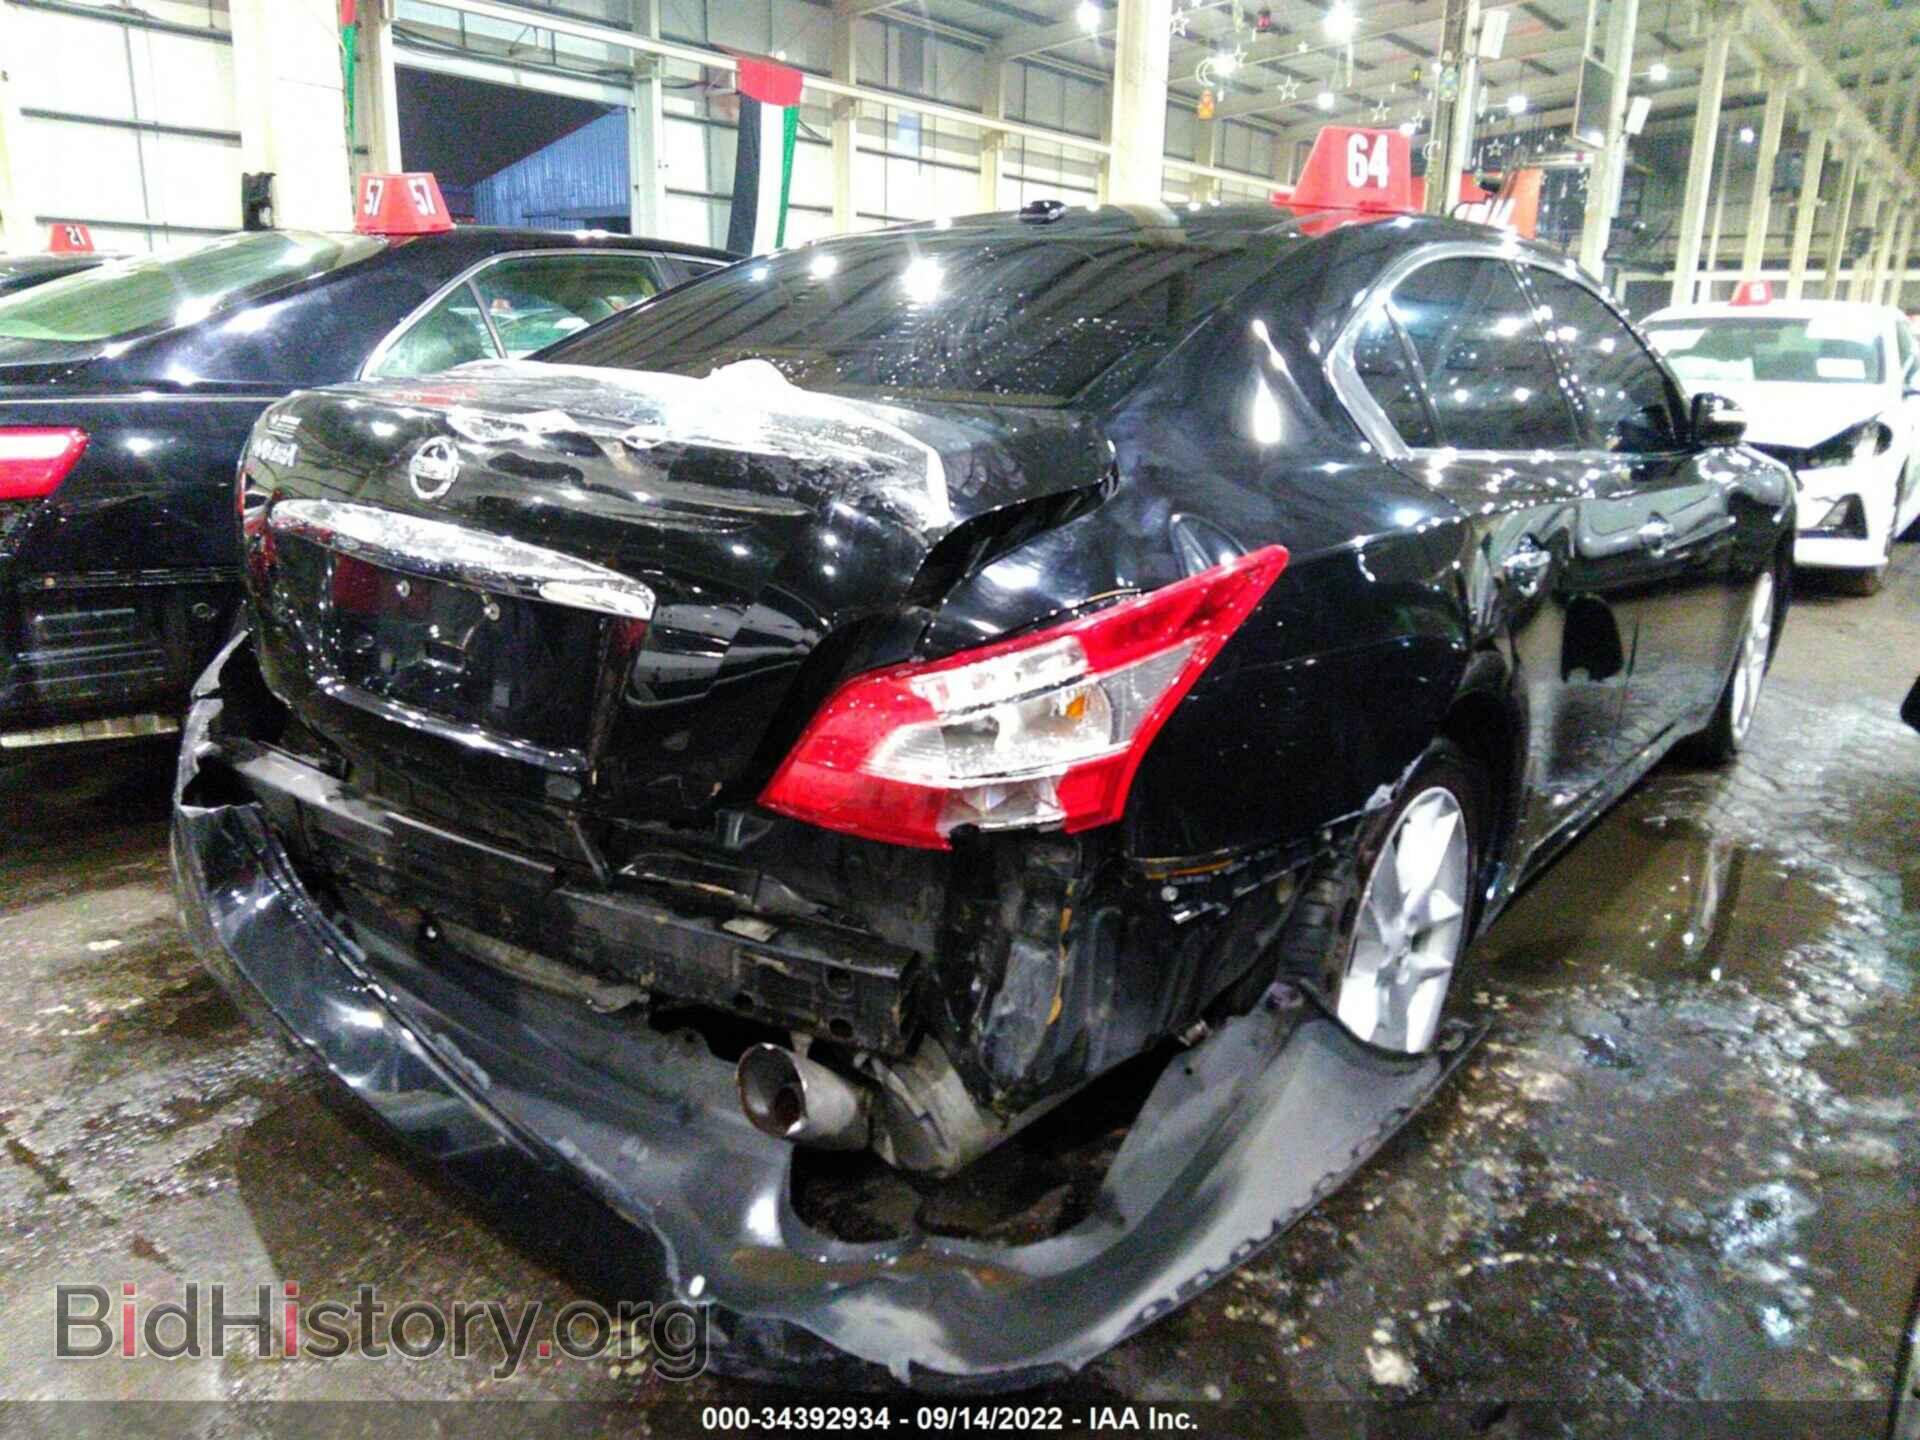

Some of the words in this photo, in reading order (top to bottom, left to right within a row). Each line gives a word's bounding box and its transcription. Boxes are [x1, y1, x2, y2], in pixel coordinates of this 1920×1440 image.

[1346, 132, 1389, 189] 64
[363, 178, 385, 217] 57
[407, 177, 437, 217] 57
